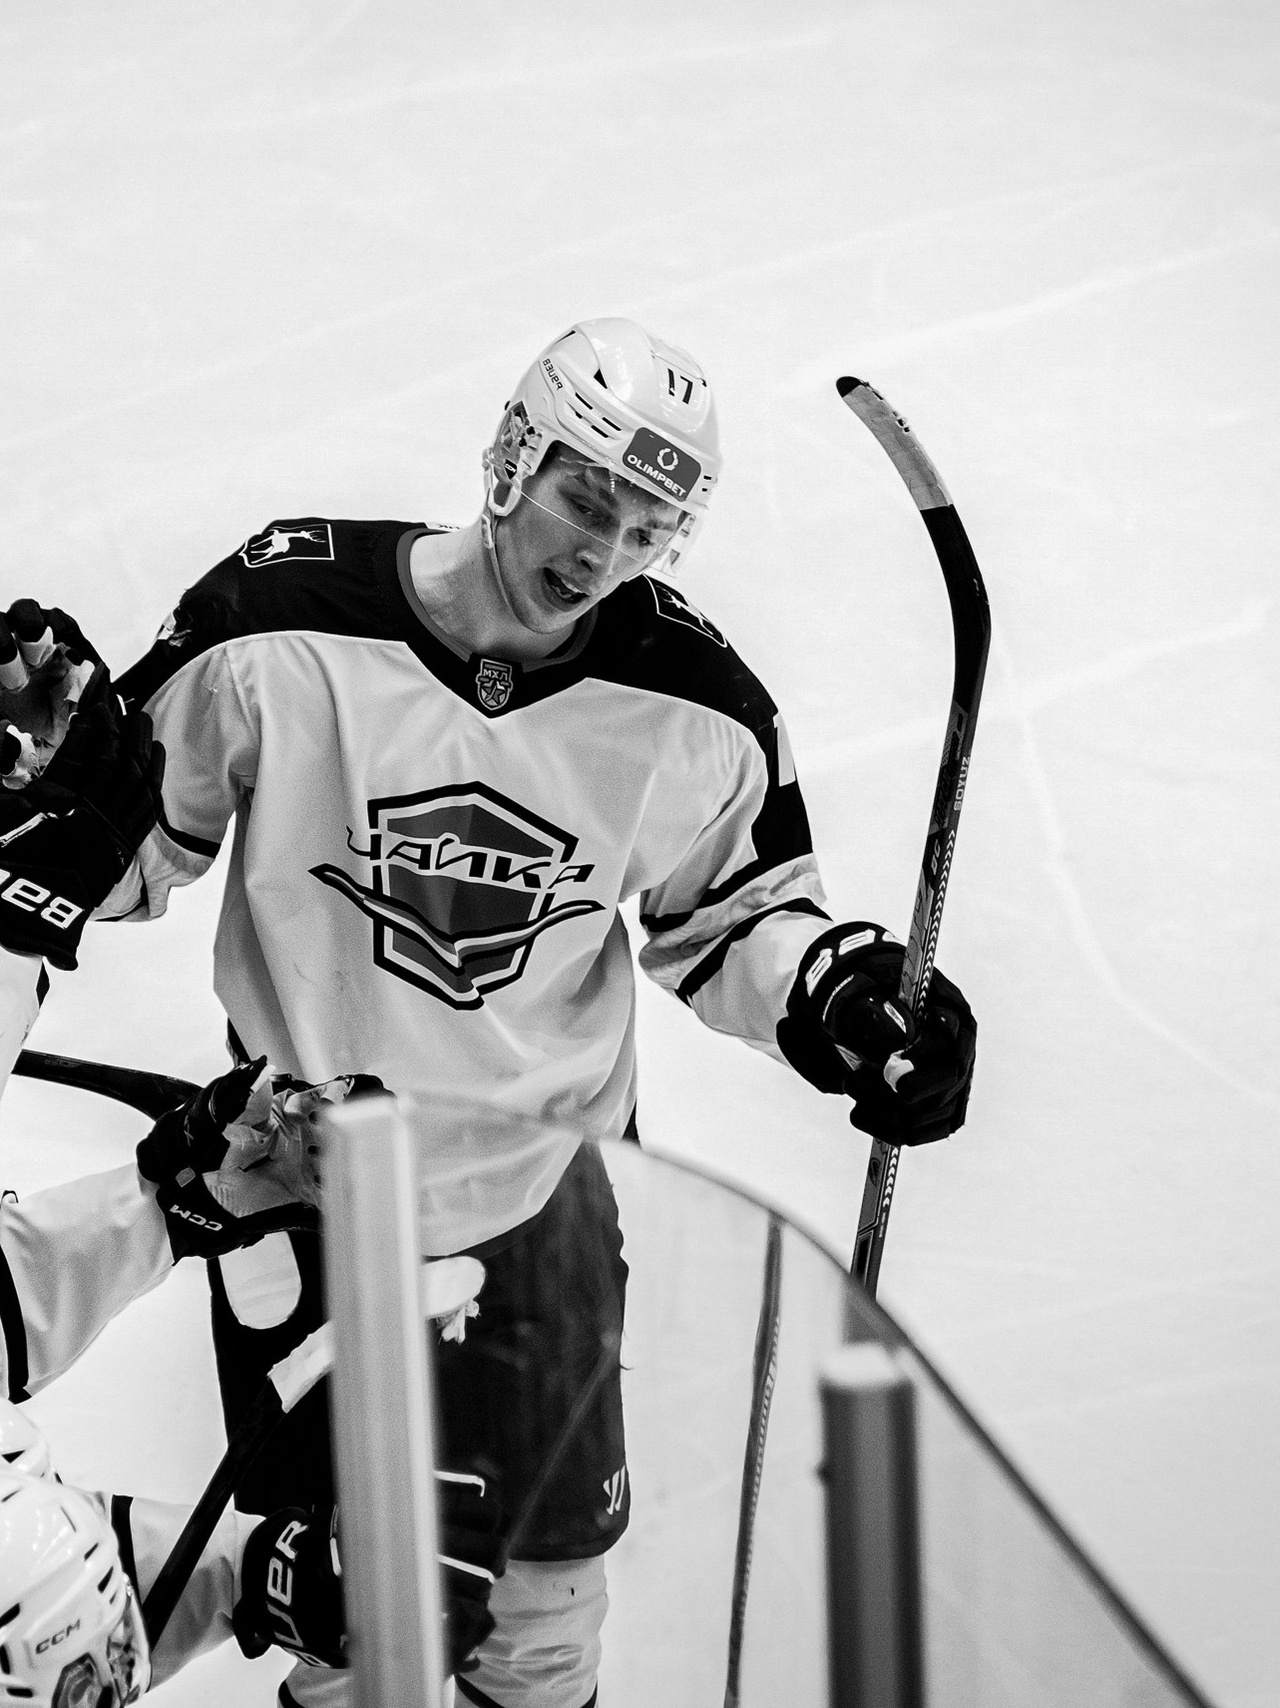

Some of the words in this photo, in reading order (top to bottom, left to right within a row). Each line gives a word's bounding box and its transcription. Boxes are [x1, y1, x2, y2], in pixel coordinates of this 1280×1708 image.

[542, 358, 564, 391] BAUER
[667, 367, 693, 404] 17
[626, 454, 687, 497] OLIMPBET
[483, 668, 508, 681] МХЛ
[346, 825, 596, 890] ЧАЙКА
[170, 1204, 223, 1232] CCM
[35, 1620, 81, 1654] CCM
